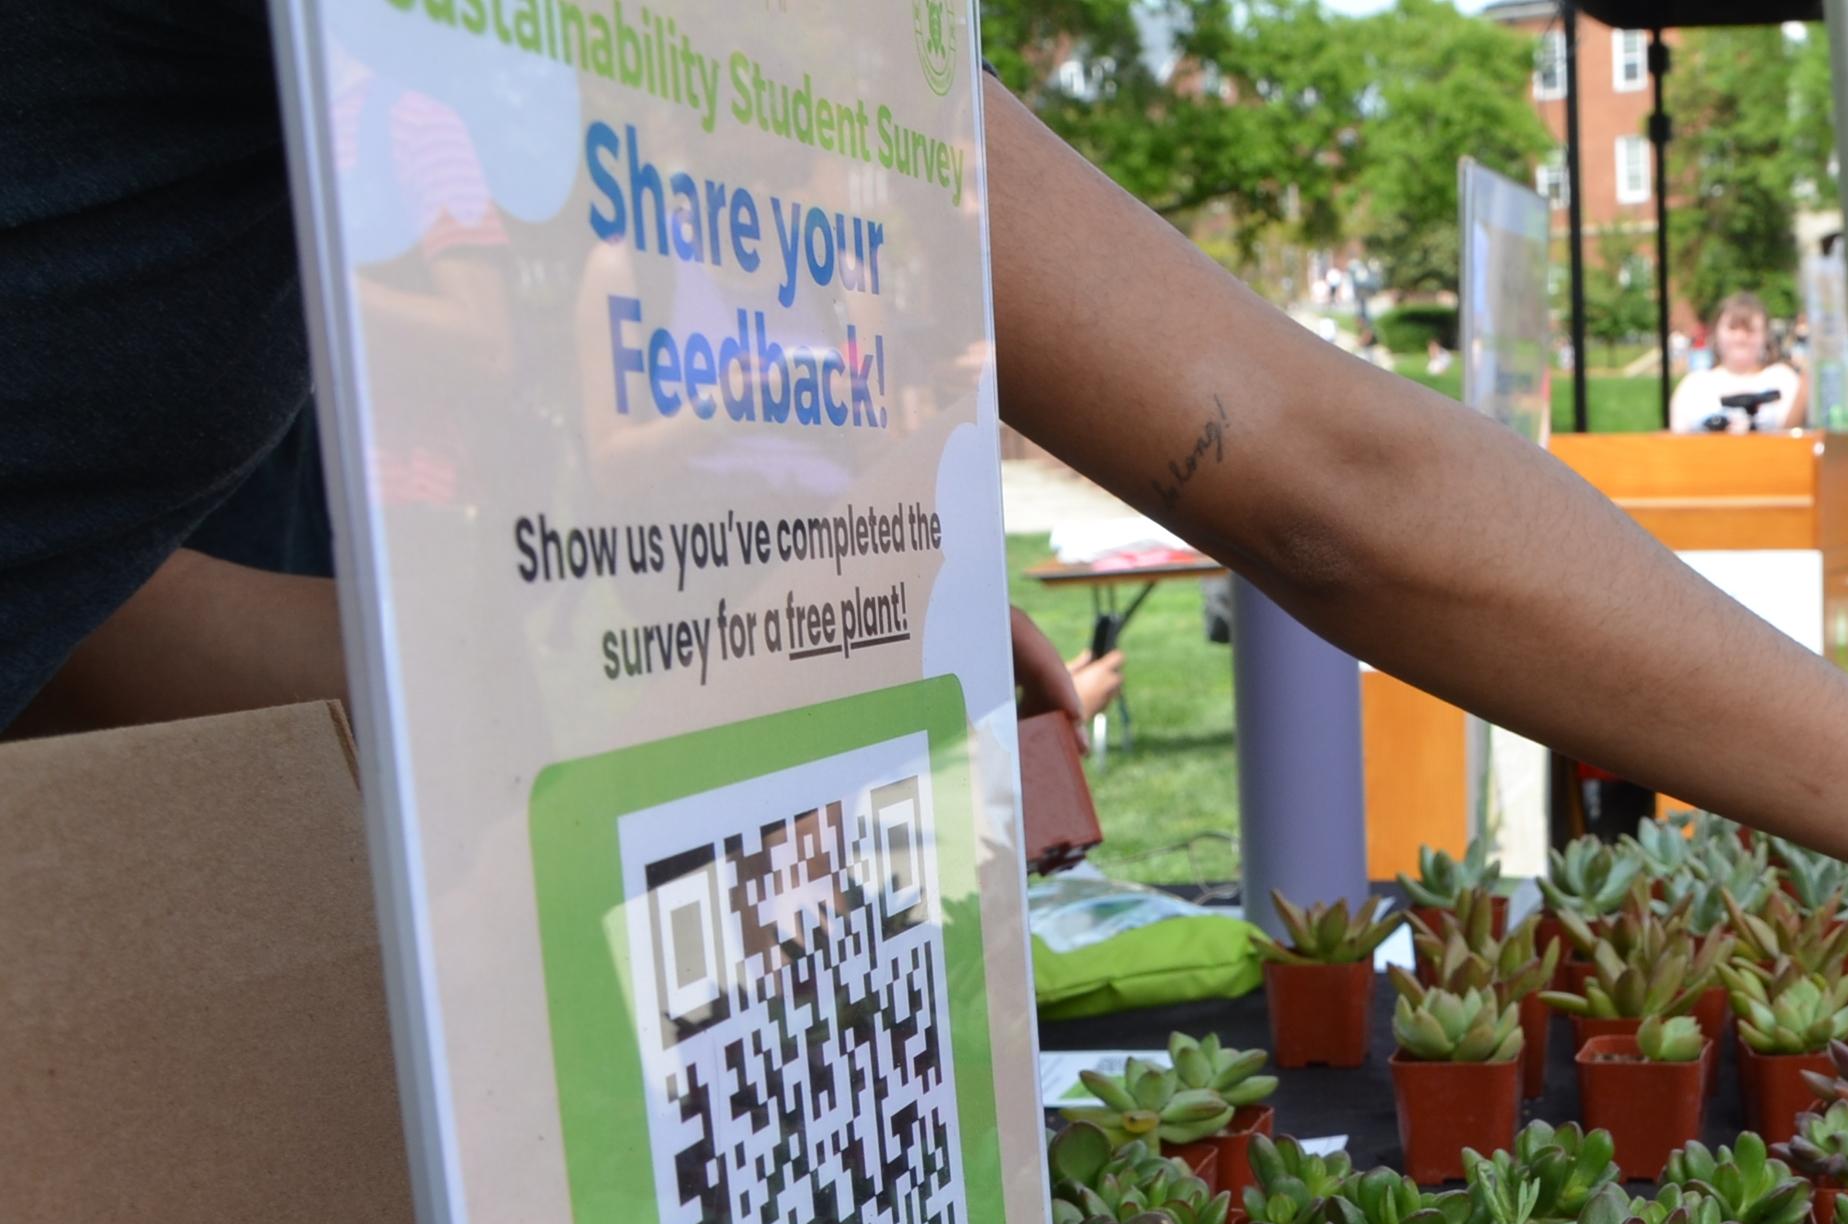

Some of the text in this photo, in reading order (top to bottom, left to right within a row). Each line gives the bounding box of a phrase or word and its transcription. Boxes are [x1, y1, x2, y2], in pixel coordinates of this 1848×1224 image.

[384, 0, 964, 207] stainability Student Survey
[585, 120, 884, 308] Share your
[607, 293, 888, 429] Feedback!
[514, 502, 942, 592] Show us you've completed the
[601, 582, 910, 686] survey for a free plant!
